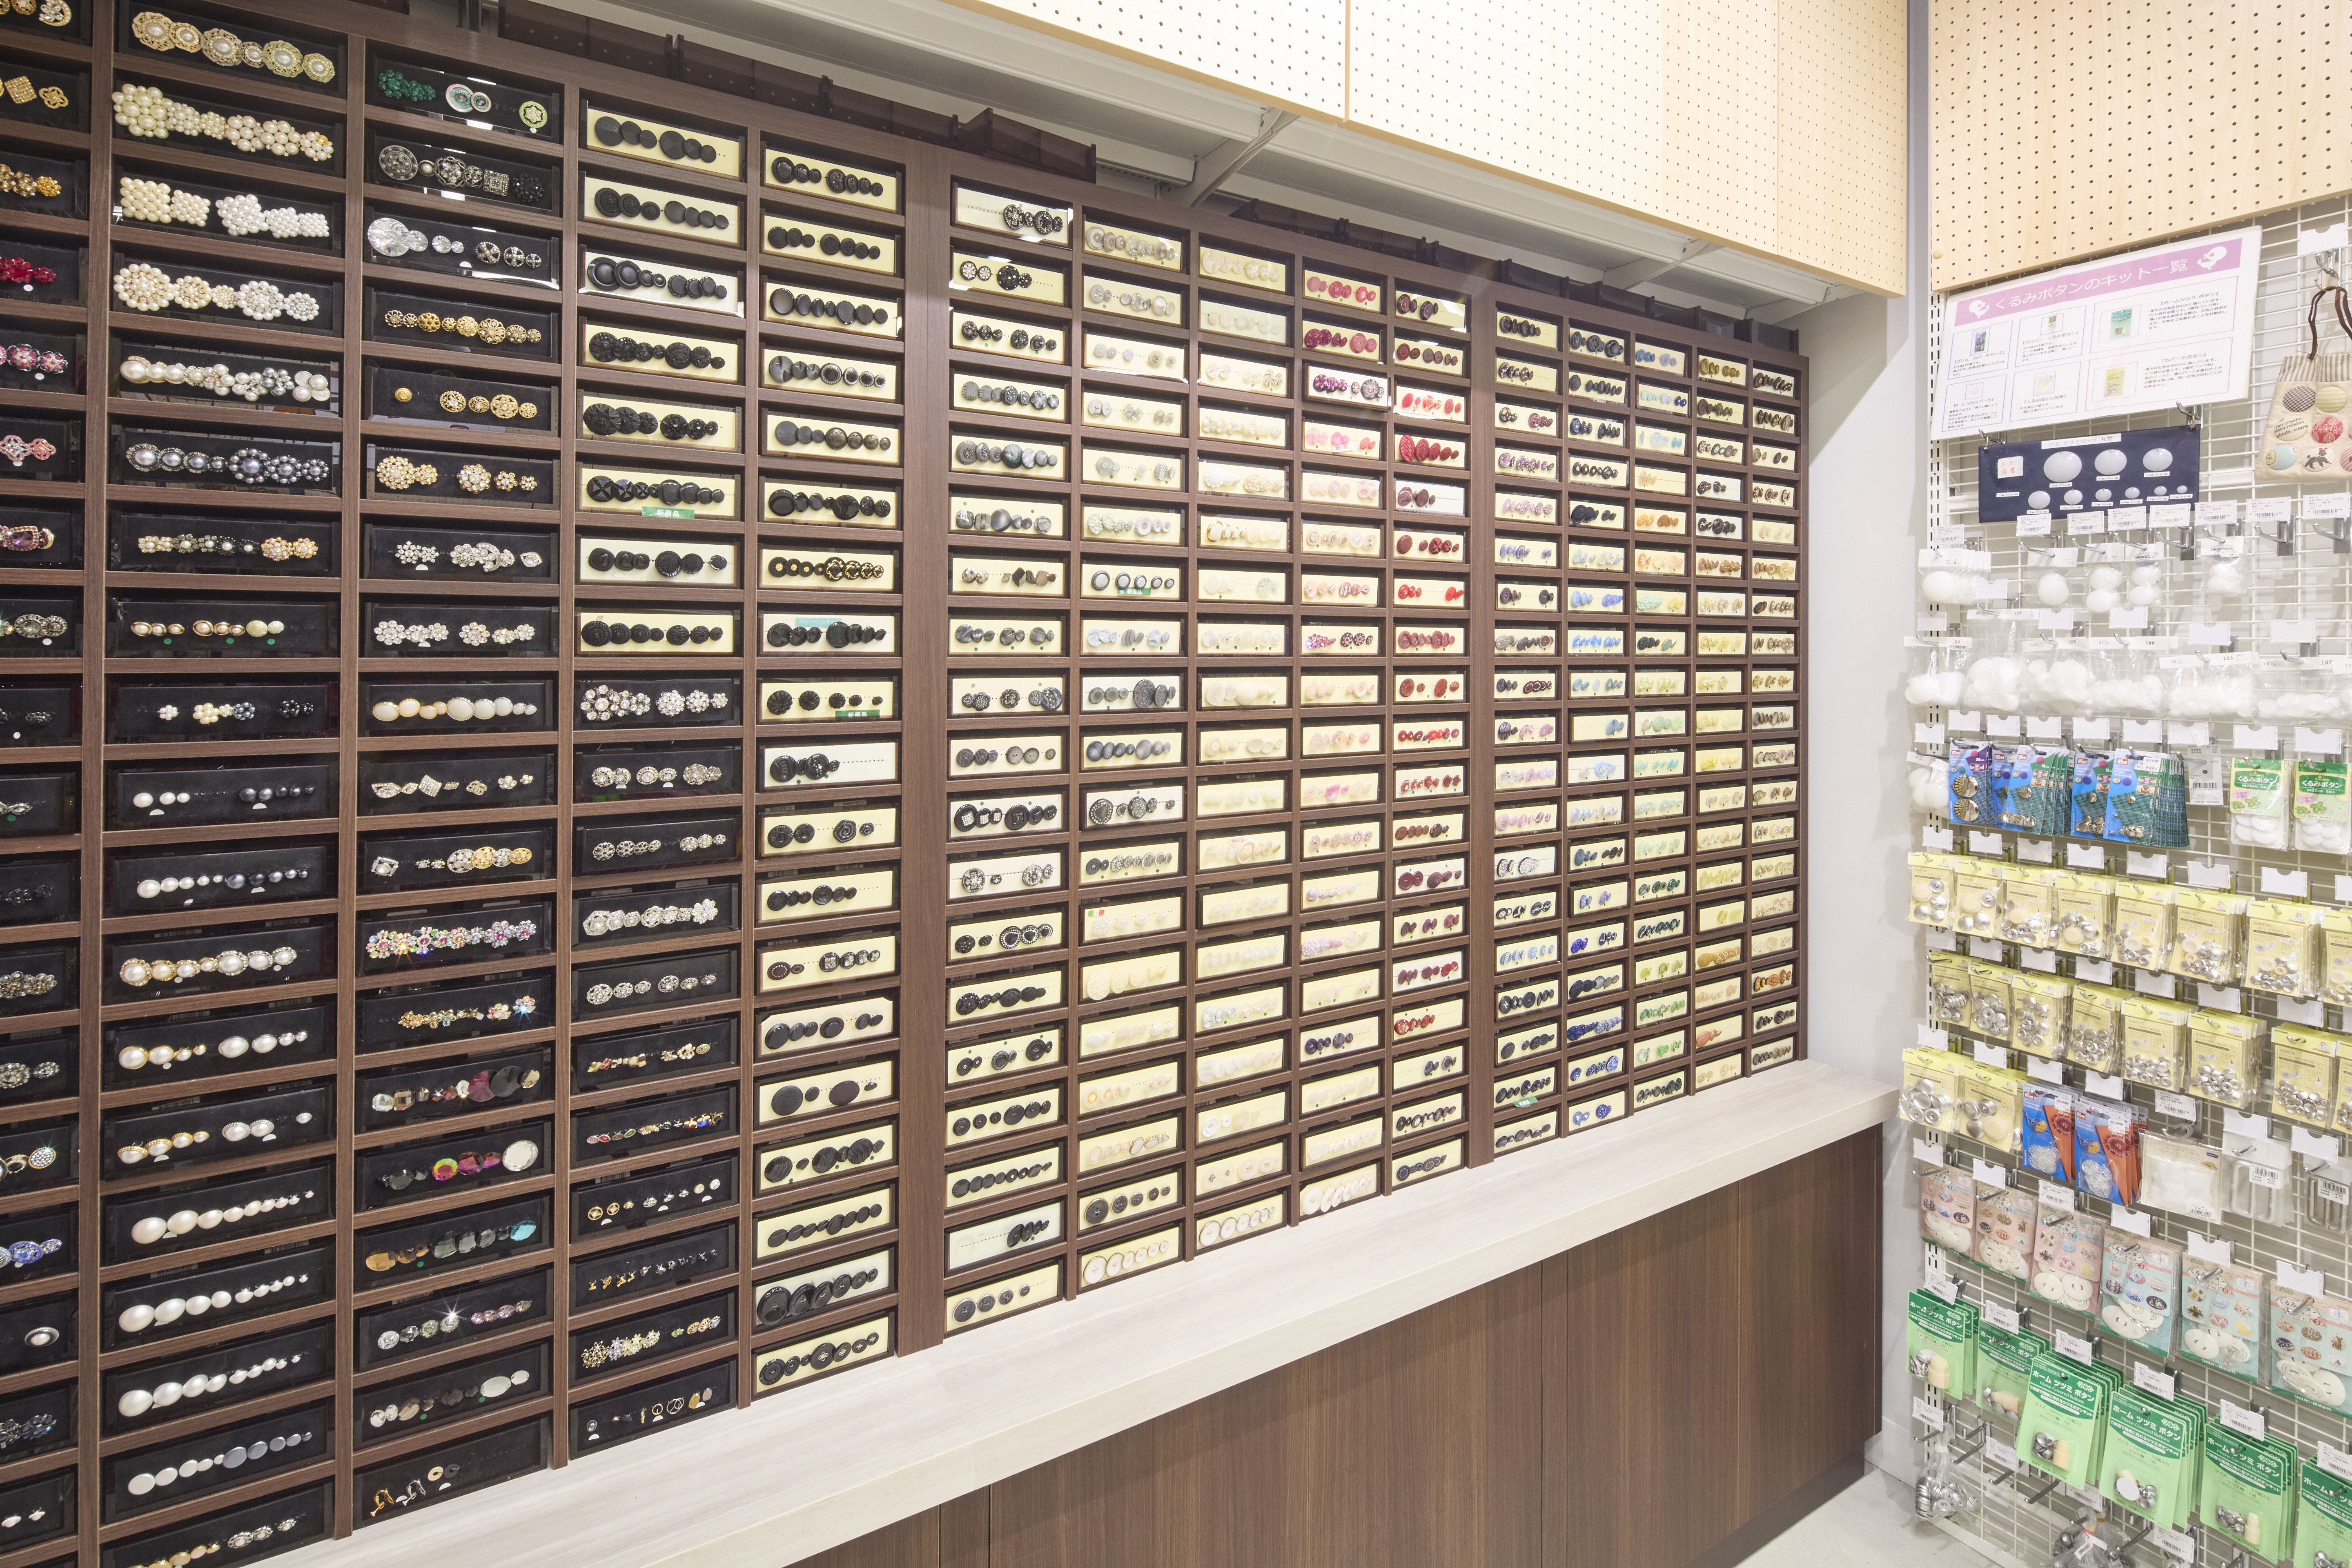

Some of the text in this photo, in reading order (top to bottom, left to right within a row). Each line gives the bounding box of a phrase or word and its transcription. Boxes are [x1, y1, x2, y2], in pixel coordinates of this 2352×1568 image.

[1996, 259, 2188, 309] くるみボタンのキット一覧
[2048, 331, 2078, 339] くるみボタン』
[2162, 353, 2206, 363] 『カバードボタン』
[2024, 394, 2066, 403] 『くるみぼたん四角』
[2287, 421, 2304, 429] raisins
[657, 509, 680, 517] 新商品
[2237, 775, 2274, 784] くるみボタン
[2302, 780, 2342, 788] くるみボタン
[1946, 1316, 1963, 1328] ボタン
[2202, 1359, 2236, 1374] クロバー株式会社
[2033, 1370, 2095, 1401] ホーム ツツミ ボタン
[2294, 1395, 2332, 1412] クロバー株式会社
[2113, 1405, 2181, 1441] ホーム ツツミ ボタン
[2207, 1437, 2229, 1453] ホーム
[2256, 1462, 2279, 1477] ボタン
[2304, 1477, 2330, 1494] ホーム
